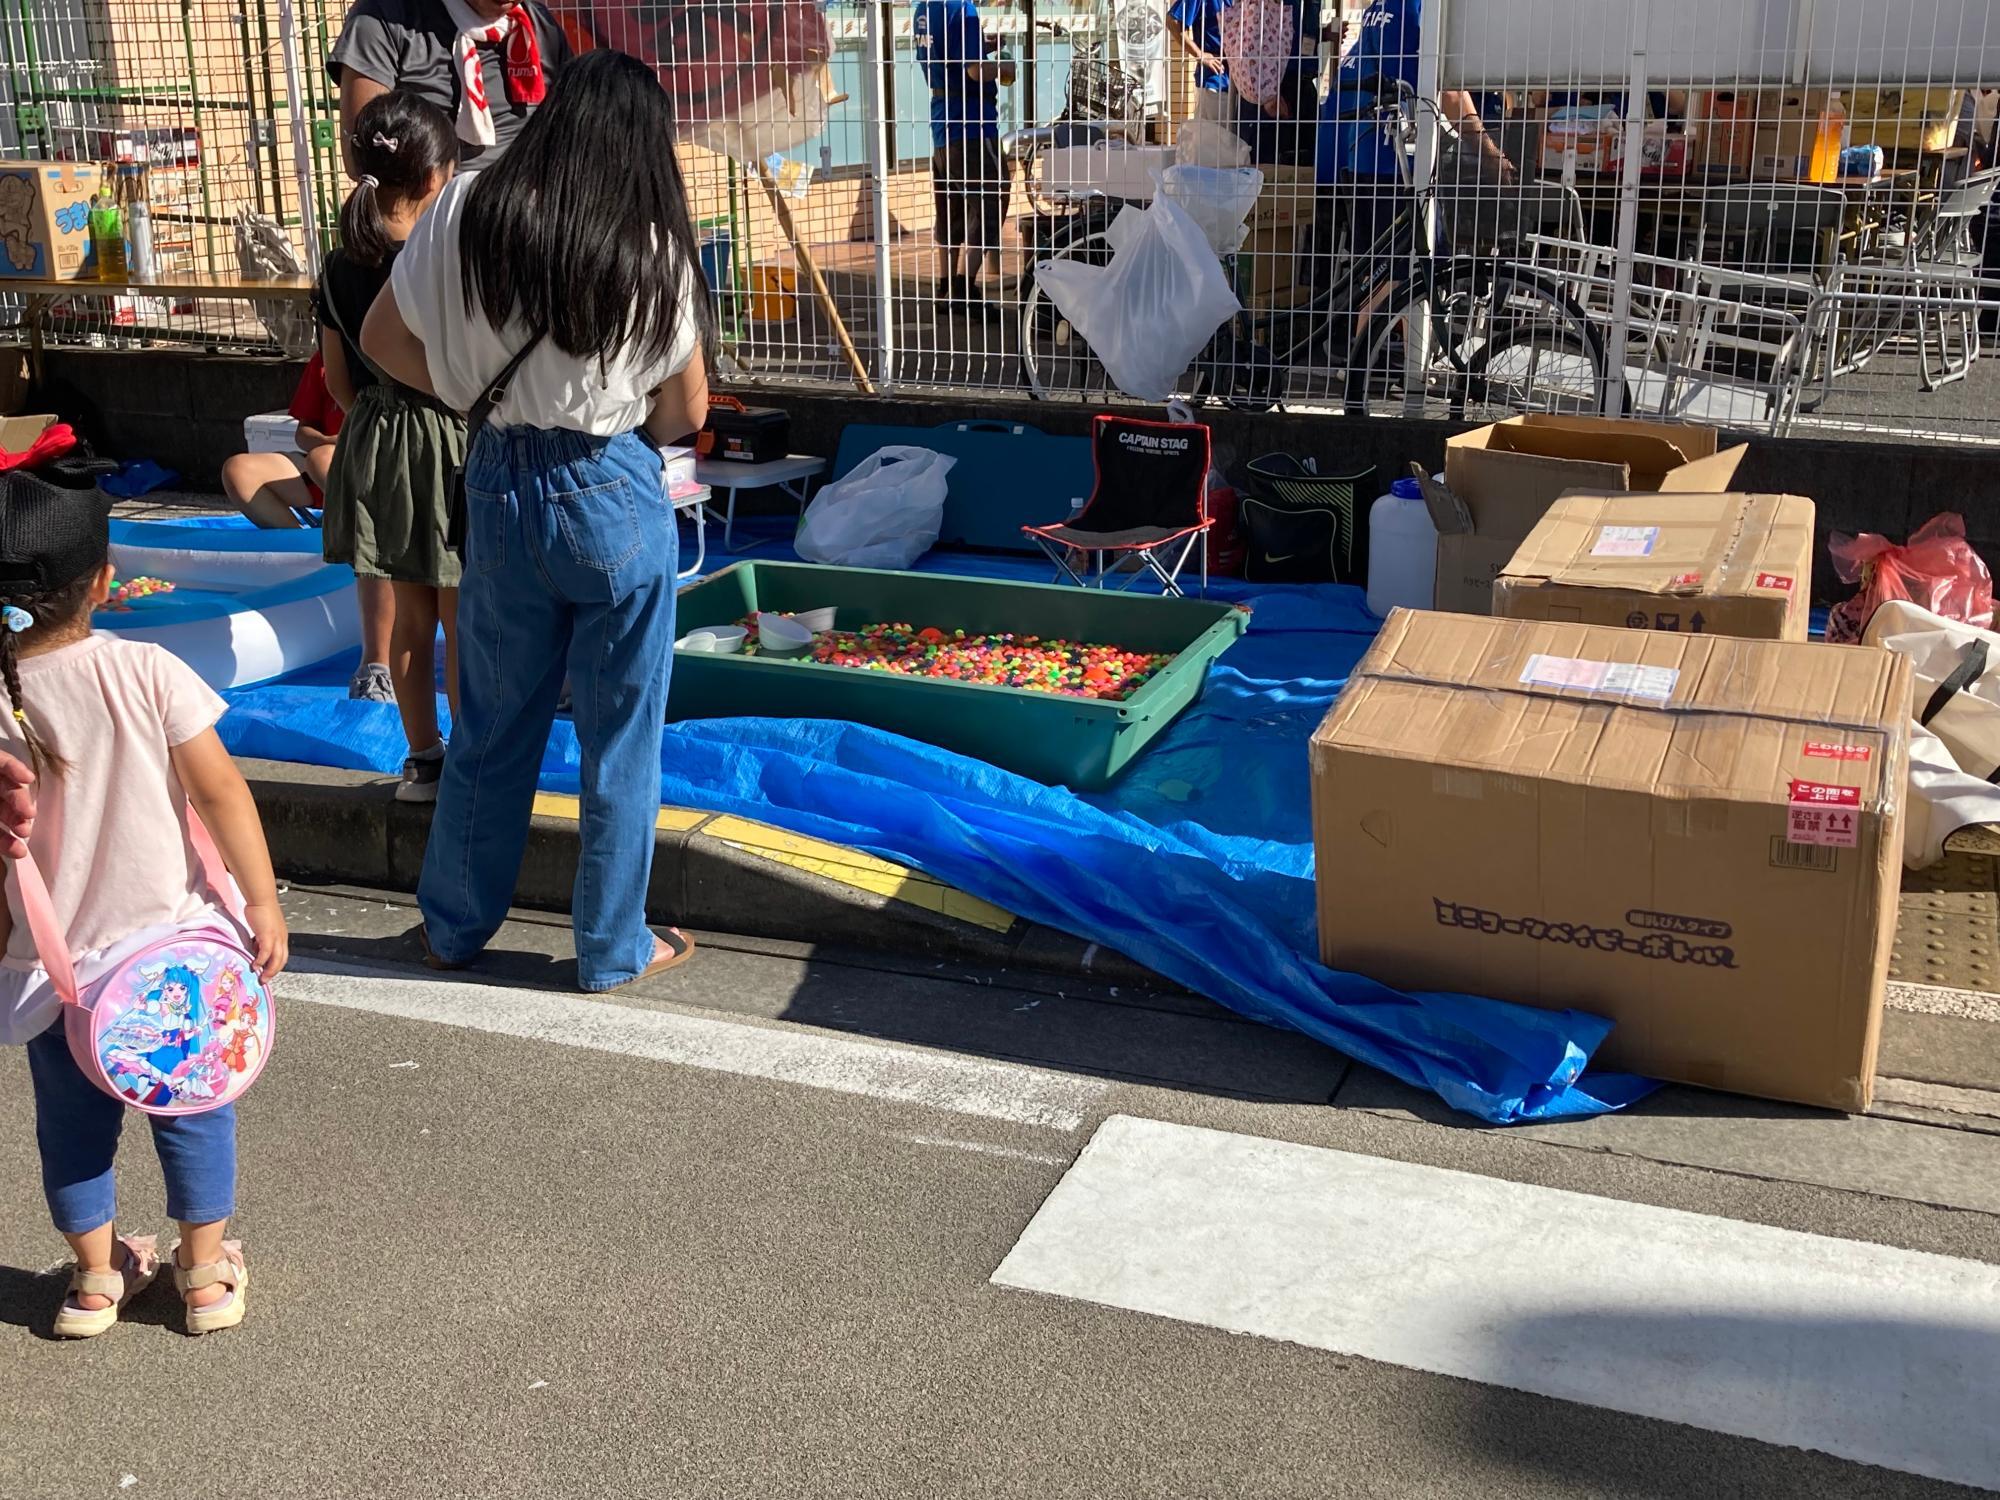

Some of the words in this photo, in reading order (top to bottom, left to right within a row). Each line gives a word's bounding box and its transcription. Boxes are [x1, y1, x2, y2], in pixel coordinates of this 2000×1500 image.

[1118, 432, 1159, 448] CAPTAIN
[1160, 437, 1189, 450] STAG
[1808, 742, 1869, 753] こわれもの
[1798, 784, 1855, 796] この面を
[1810, 793, 1840, 801] 上に
